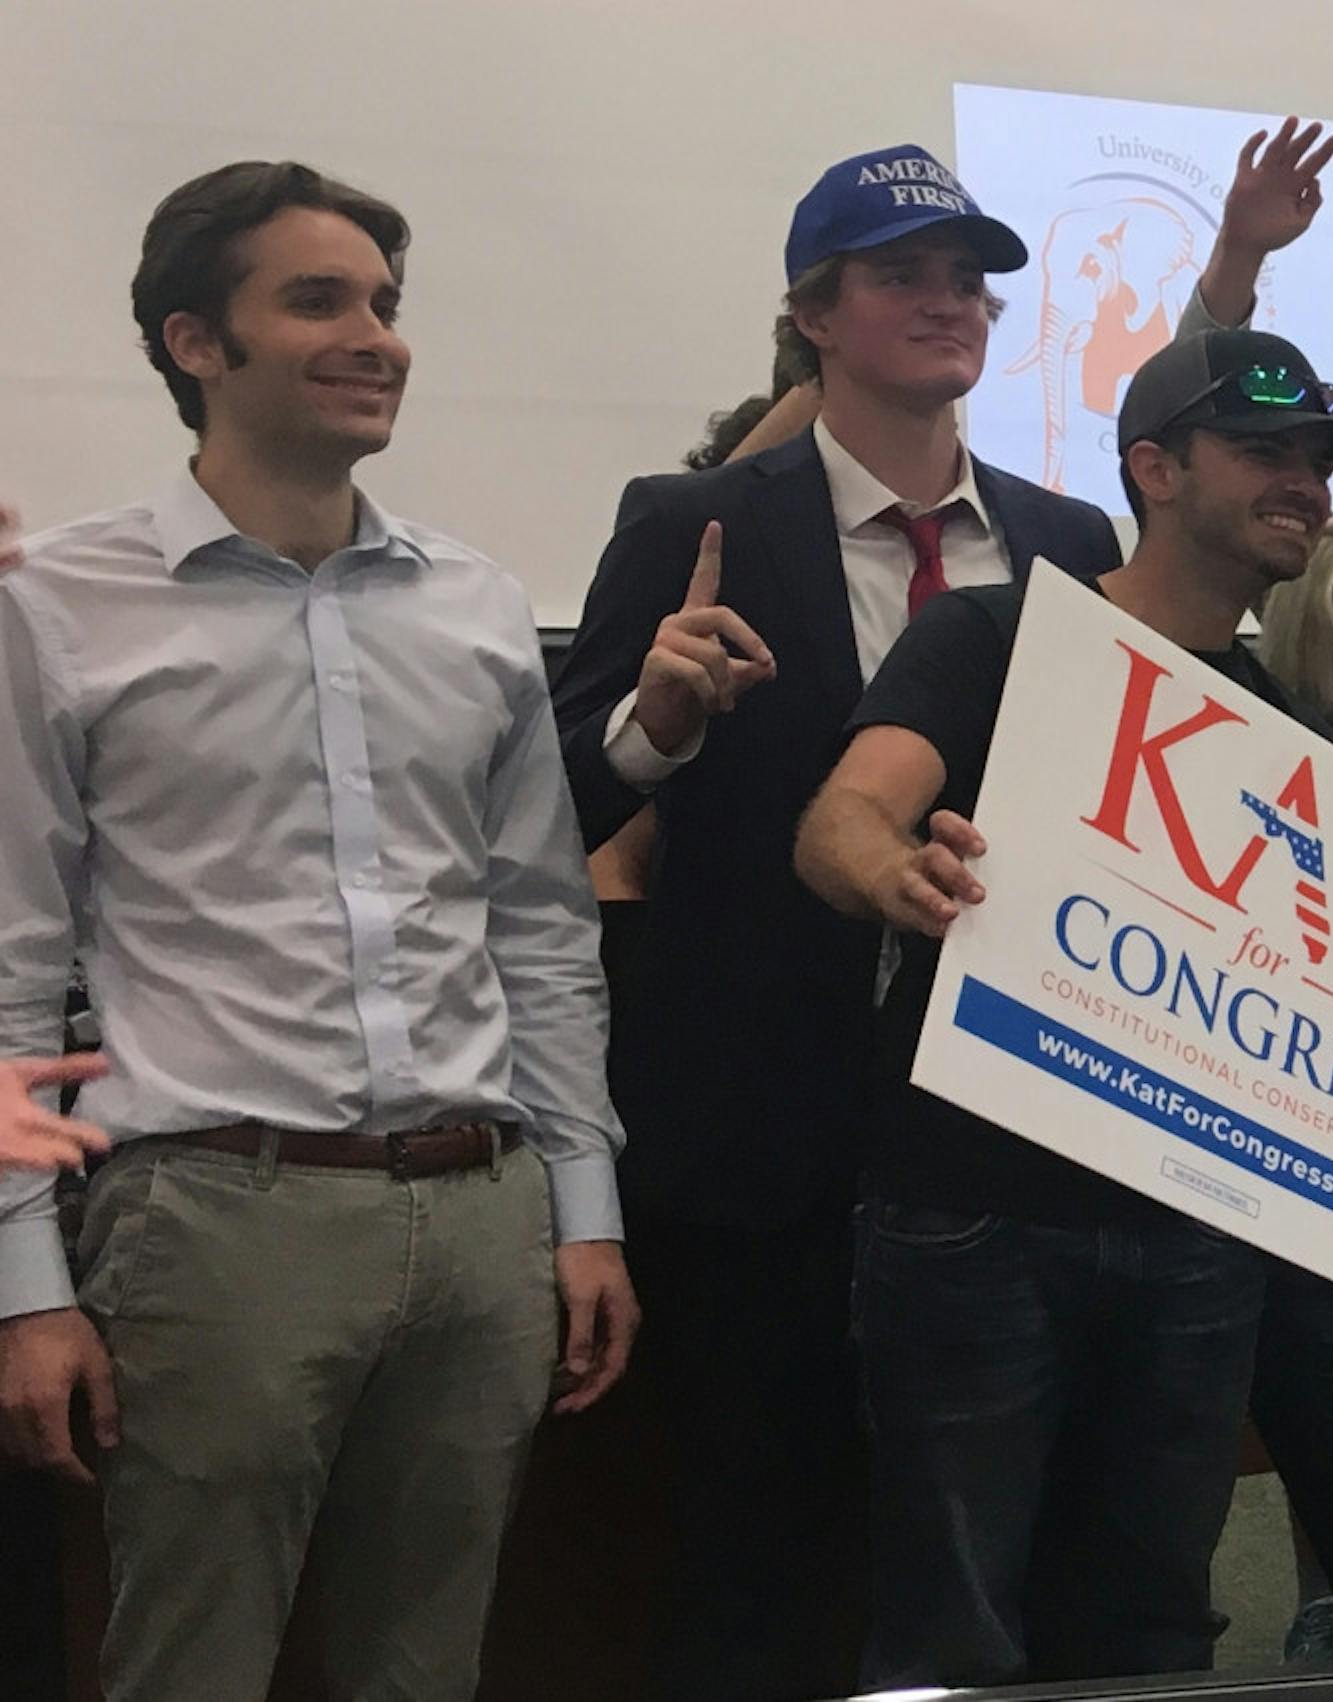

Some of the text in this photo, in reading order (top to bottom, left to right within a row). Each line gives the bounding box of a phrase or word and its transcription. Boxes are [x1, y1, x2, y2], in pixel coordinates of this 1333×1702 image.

[858, 158, 973, 201] AMERIC
[1096, 135, 1209, 189] University
[890, 184, 966, 215] FIRST
[1228, 927, 1289, 975] for
[1041, 971, 1242, 1090] CONSTITUTIONAL
